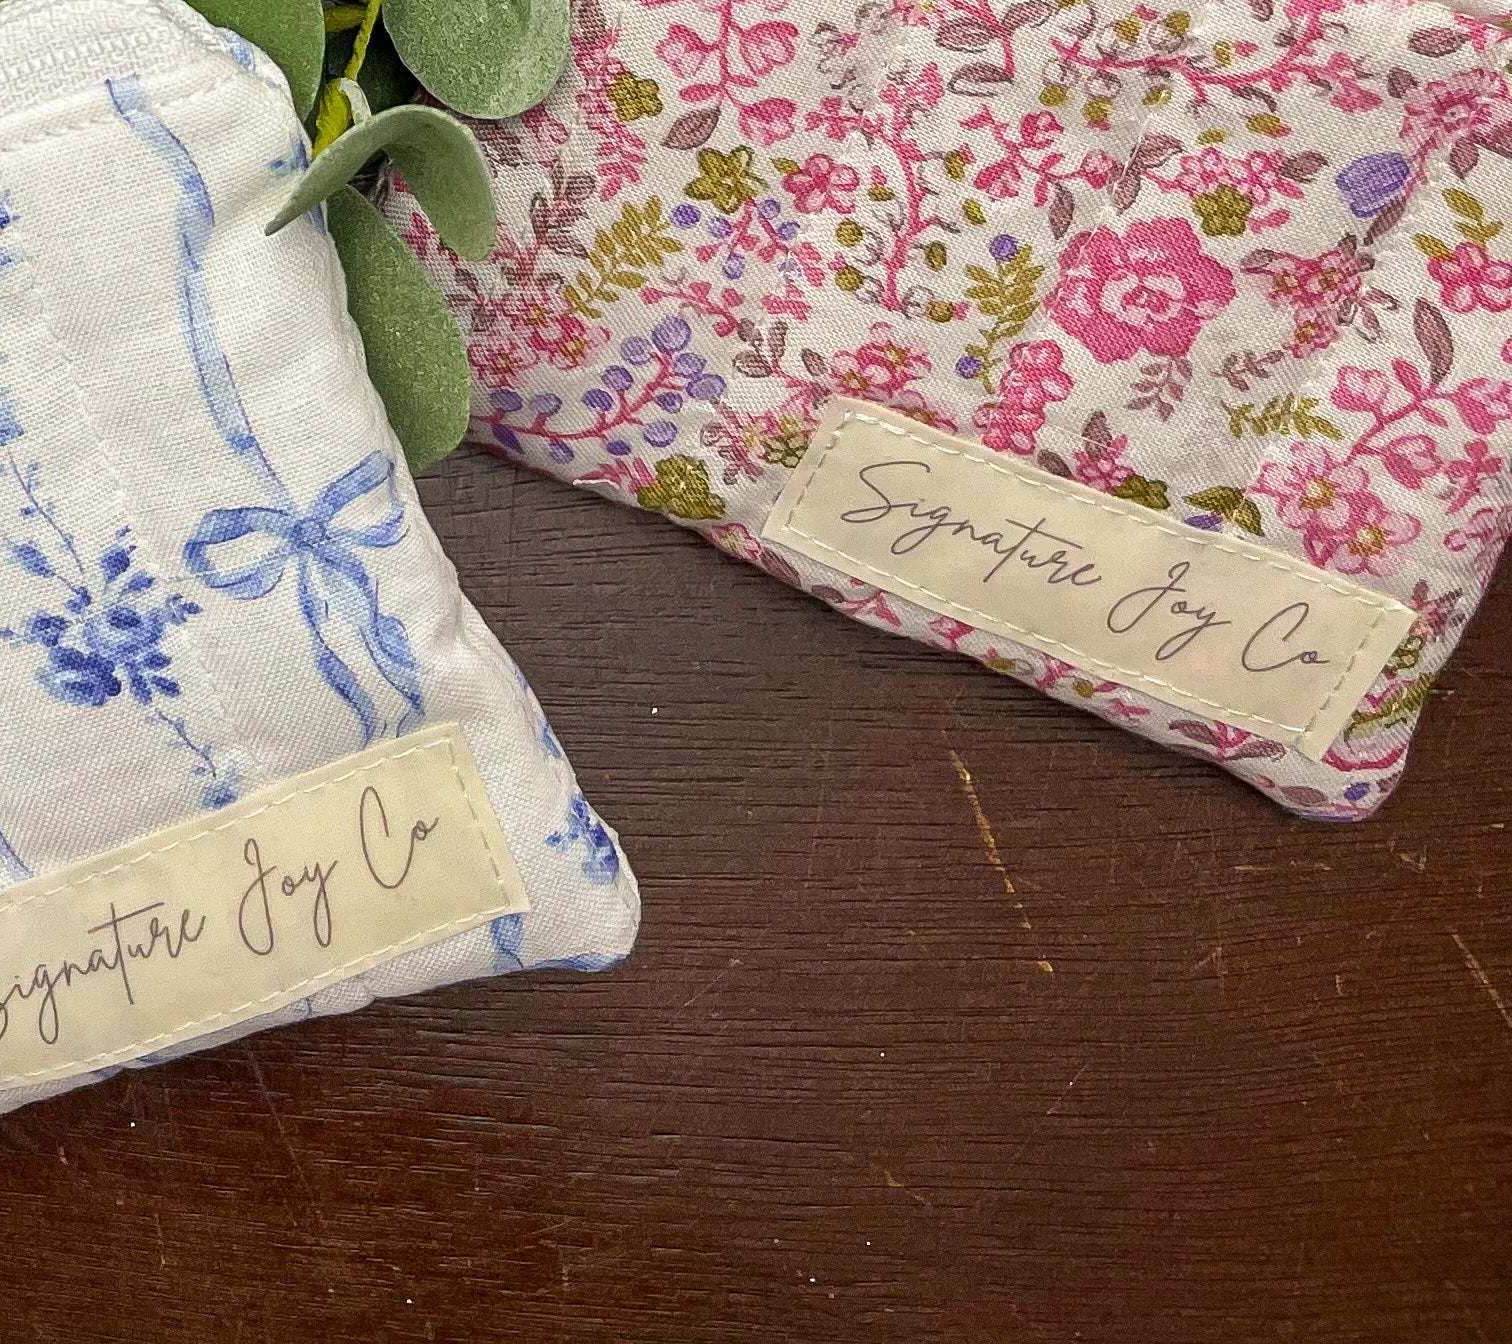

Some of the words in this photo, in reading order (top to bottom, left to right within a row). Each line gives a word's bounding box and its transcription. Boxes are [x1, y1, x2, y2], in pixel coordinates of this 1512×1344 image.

[841, 460, 1103, 587] Signature
[1106, 560, 1232, 661] Joy
[1240, 602, 1331, 673] Co
[238, 838, 340, 956] Joy
[359, 786, 440, 889] Co
